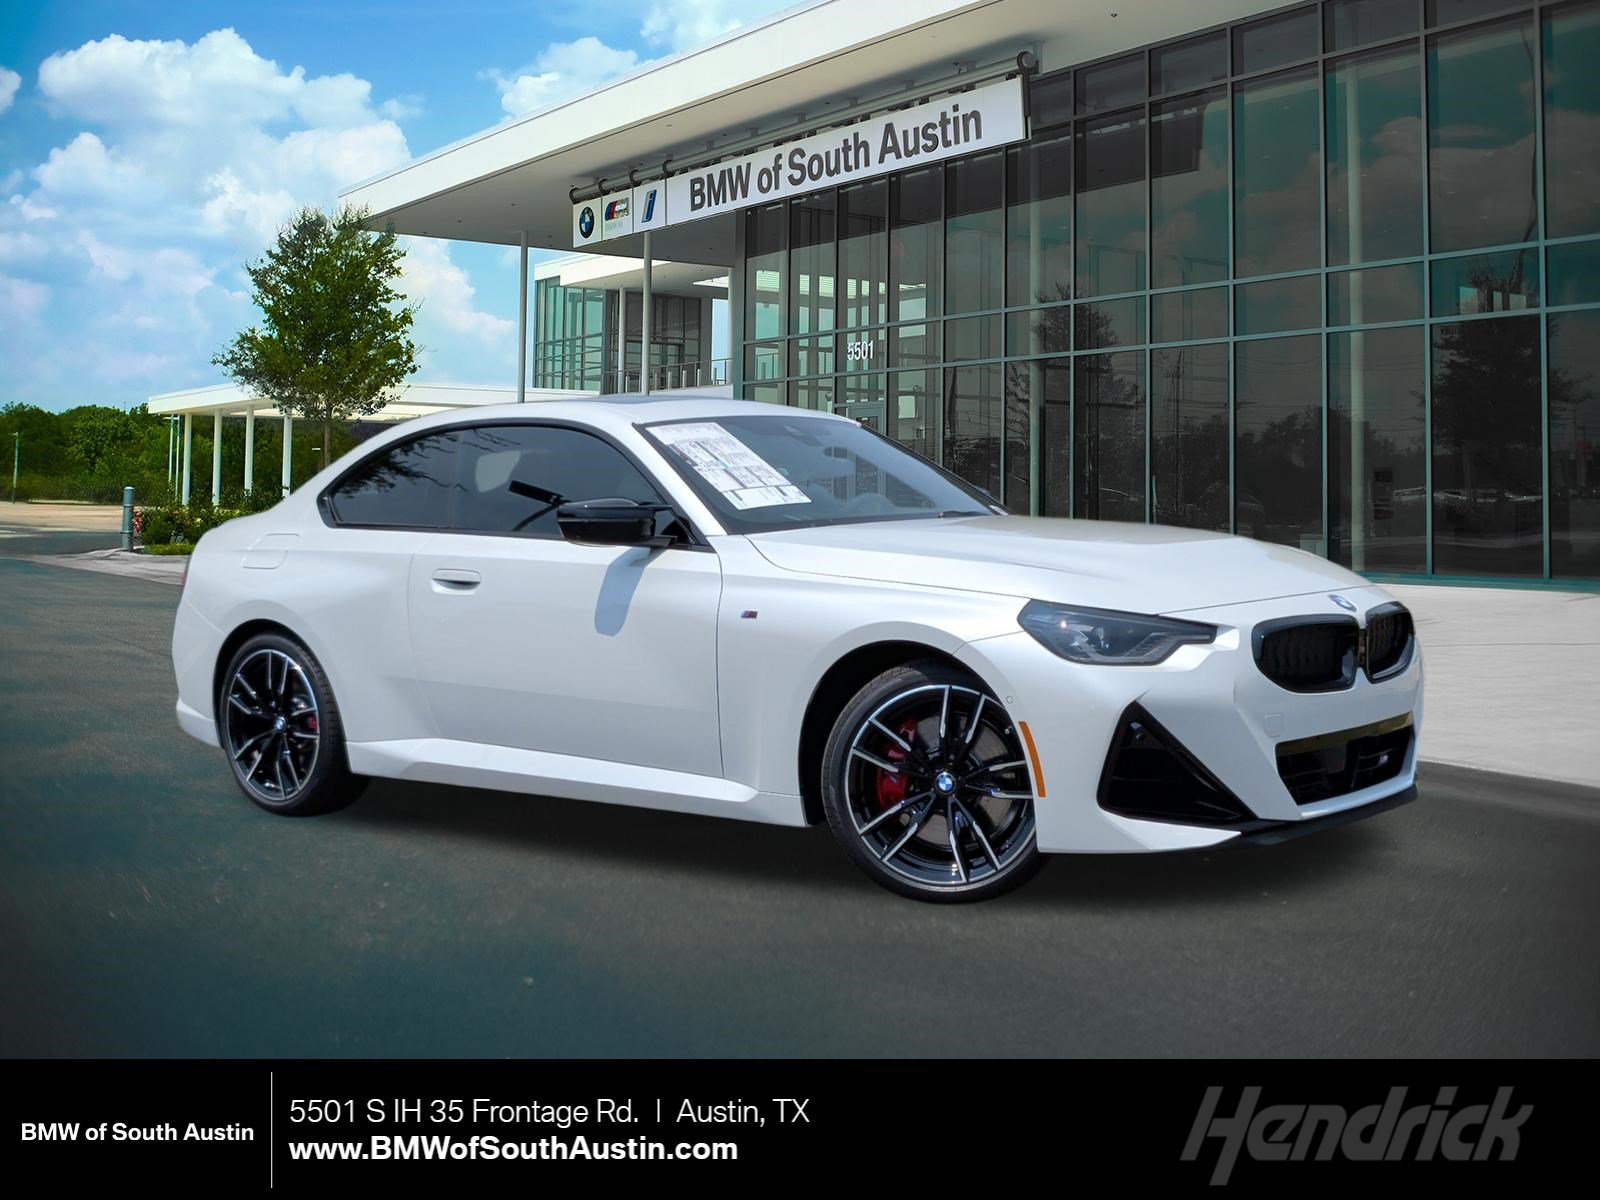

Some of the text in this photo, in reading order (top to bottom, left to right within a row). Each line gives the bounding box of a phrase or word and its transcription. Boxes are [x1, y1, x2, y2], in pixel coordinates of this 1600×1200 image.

[689, 162, 751, 212] BMW
[757, 154, 783, 194] of
[787, 132, 871, 186] South
[878, 104, 983, 164] Austin
[847, 340, 874, 360] 5501
